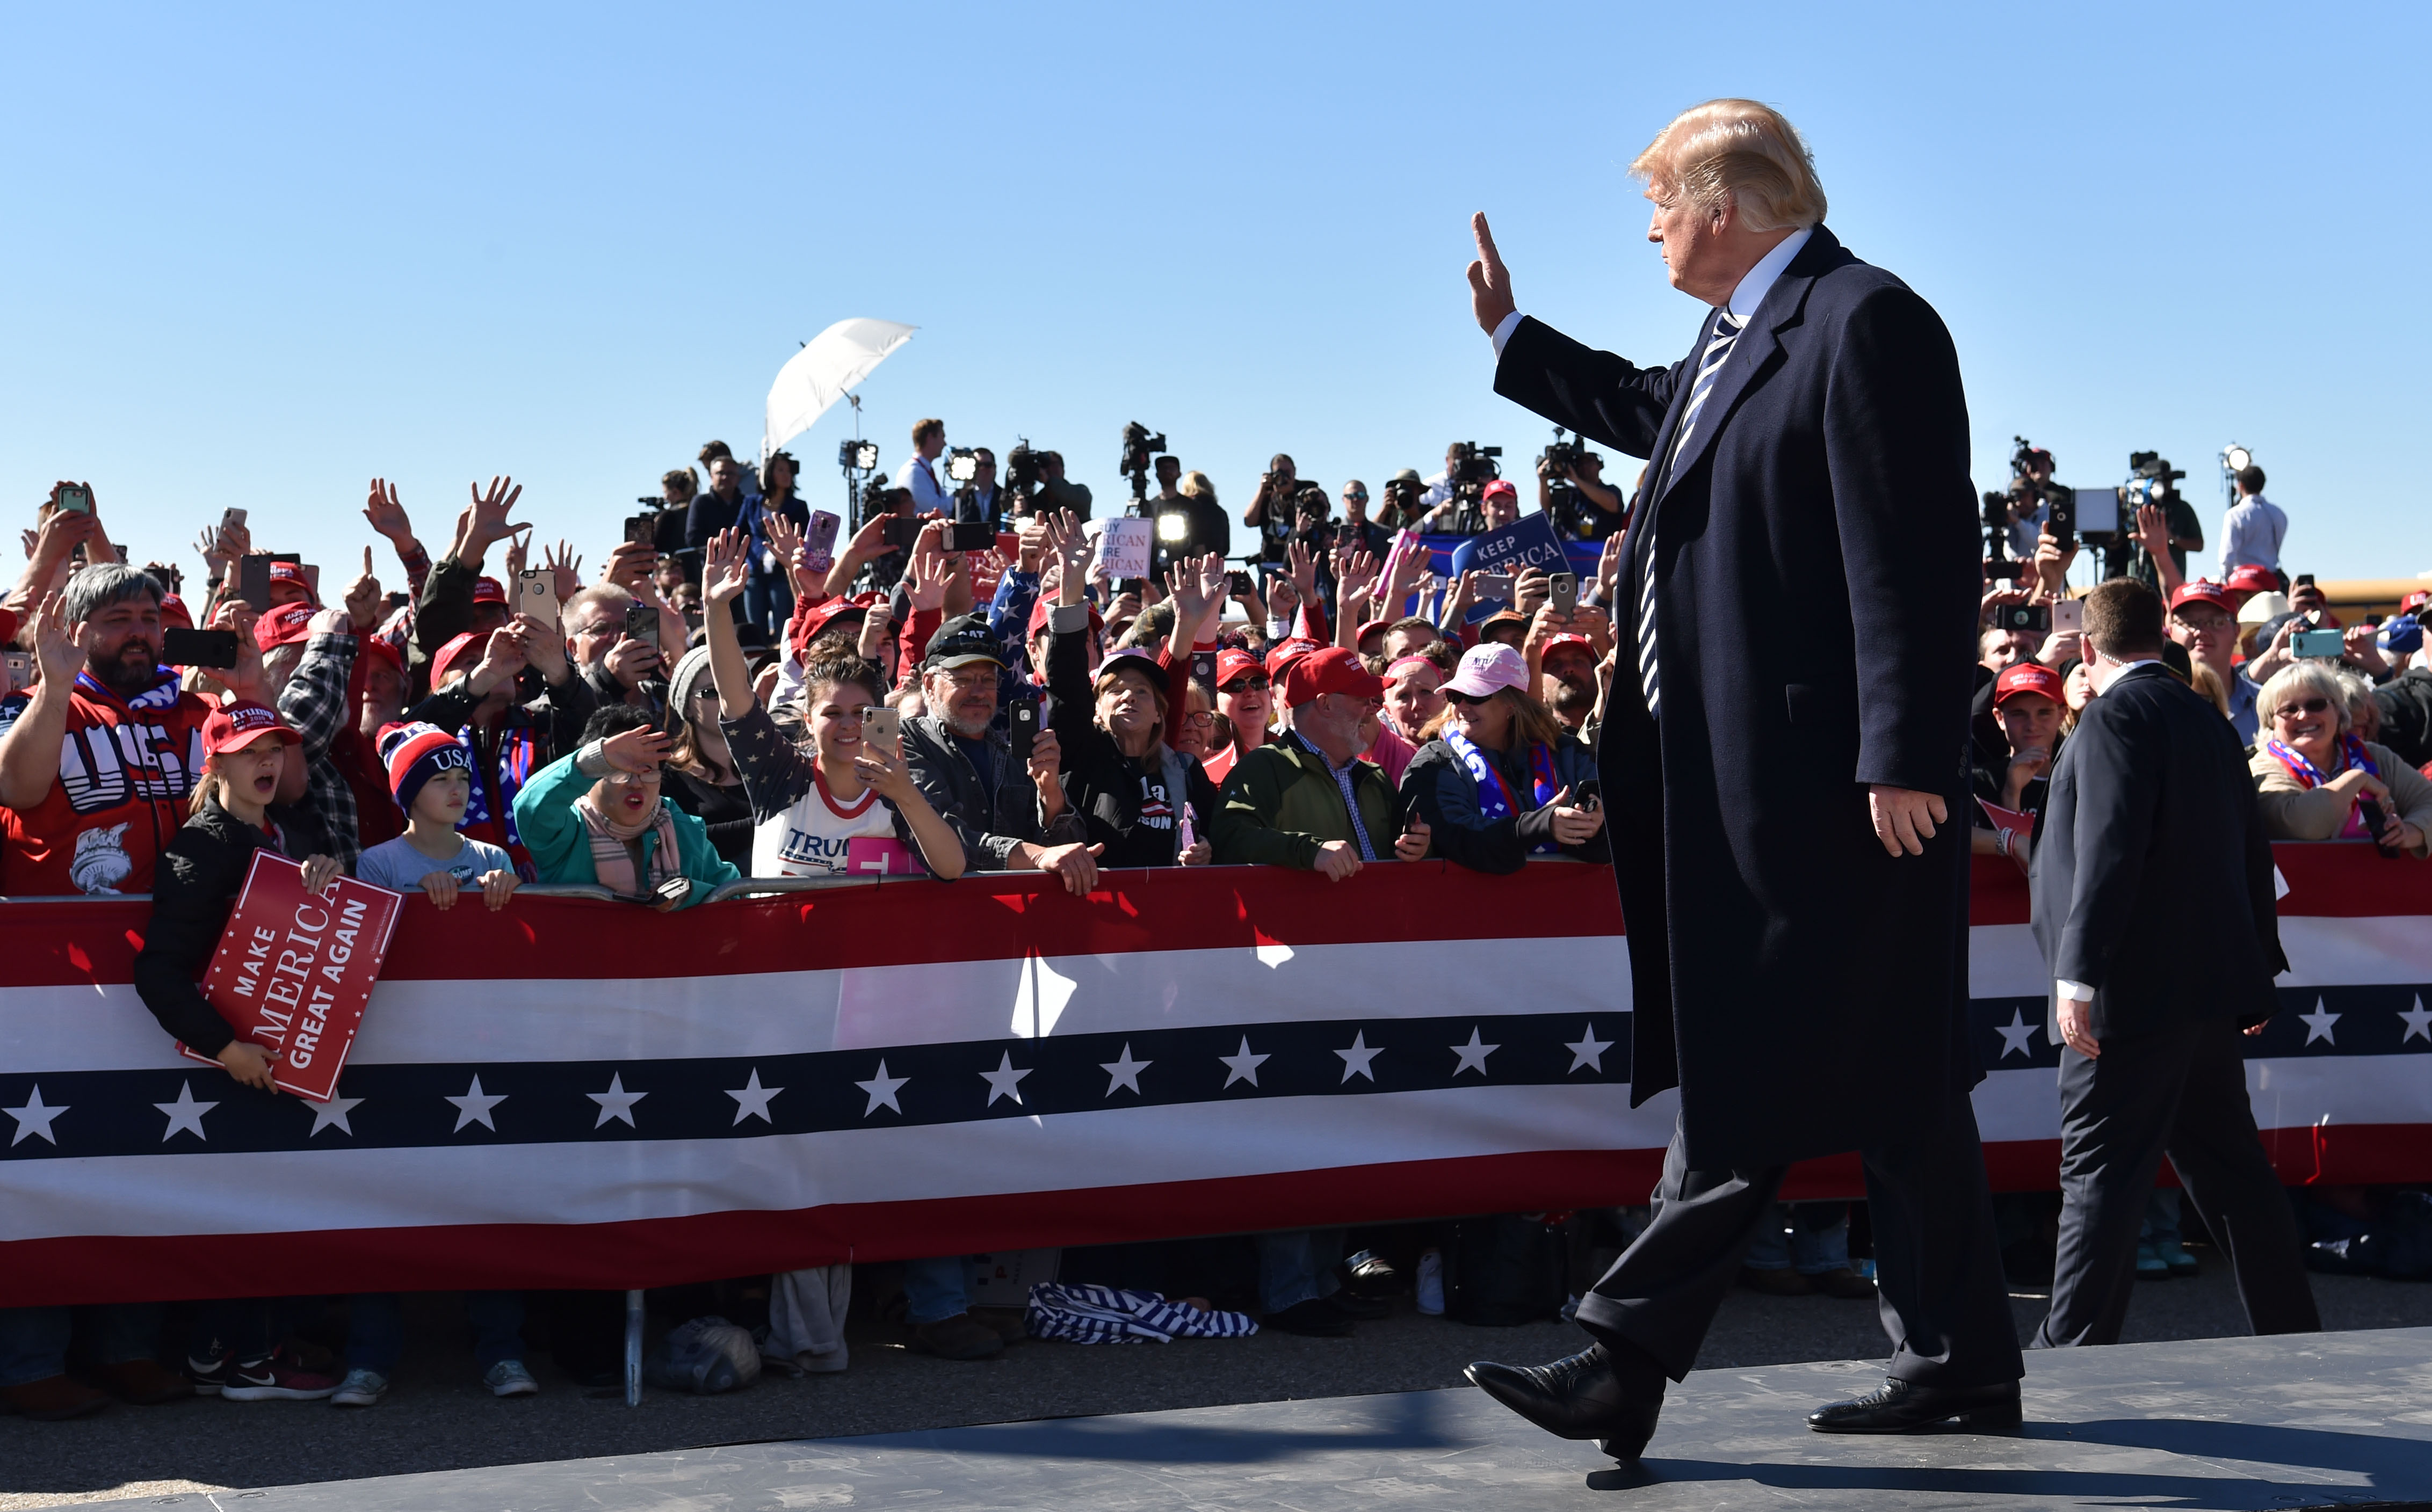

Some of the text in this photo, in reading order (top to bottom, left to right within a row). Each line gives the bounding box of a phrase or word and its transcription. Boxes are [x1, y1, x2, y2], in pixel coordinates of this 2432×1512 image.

[1103, 534, 1145, 547] RICAN
[1477, 536, 1515, 561] KEEP
[1102, 558, 1144, 571] RICAN
[1481, 542, 1559, 575] ERICA
[227, 708, 274, 723] Trump
[431, 749, 473, 773] USA
[1137, 816, 1171, 830] SON
[452, 868, 473, 879] RUMP
[233, 926, 276, 997] MAKE
[251, 881, 342, 1073] MERICA
[289, 898, 368, 1070] GREAT AGAIN
